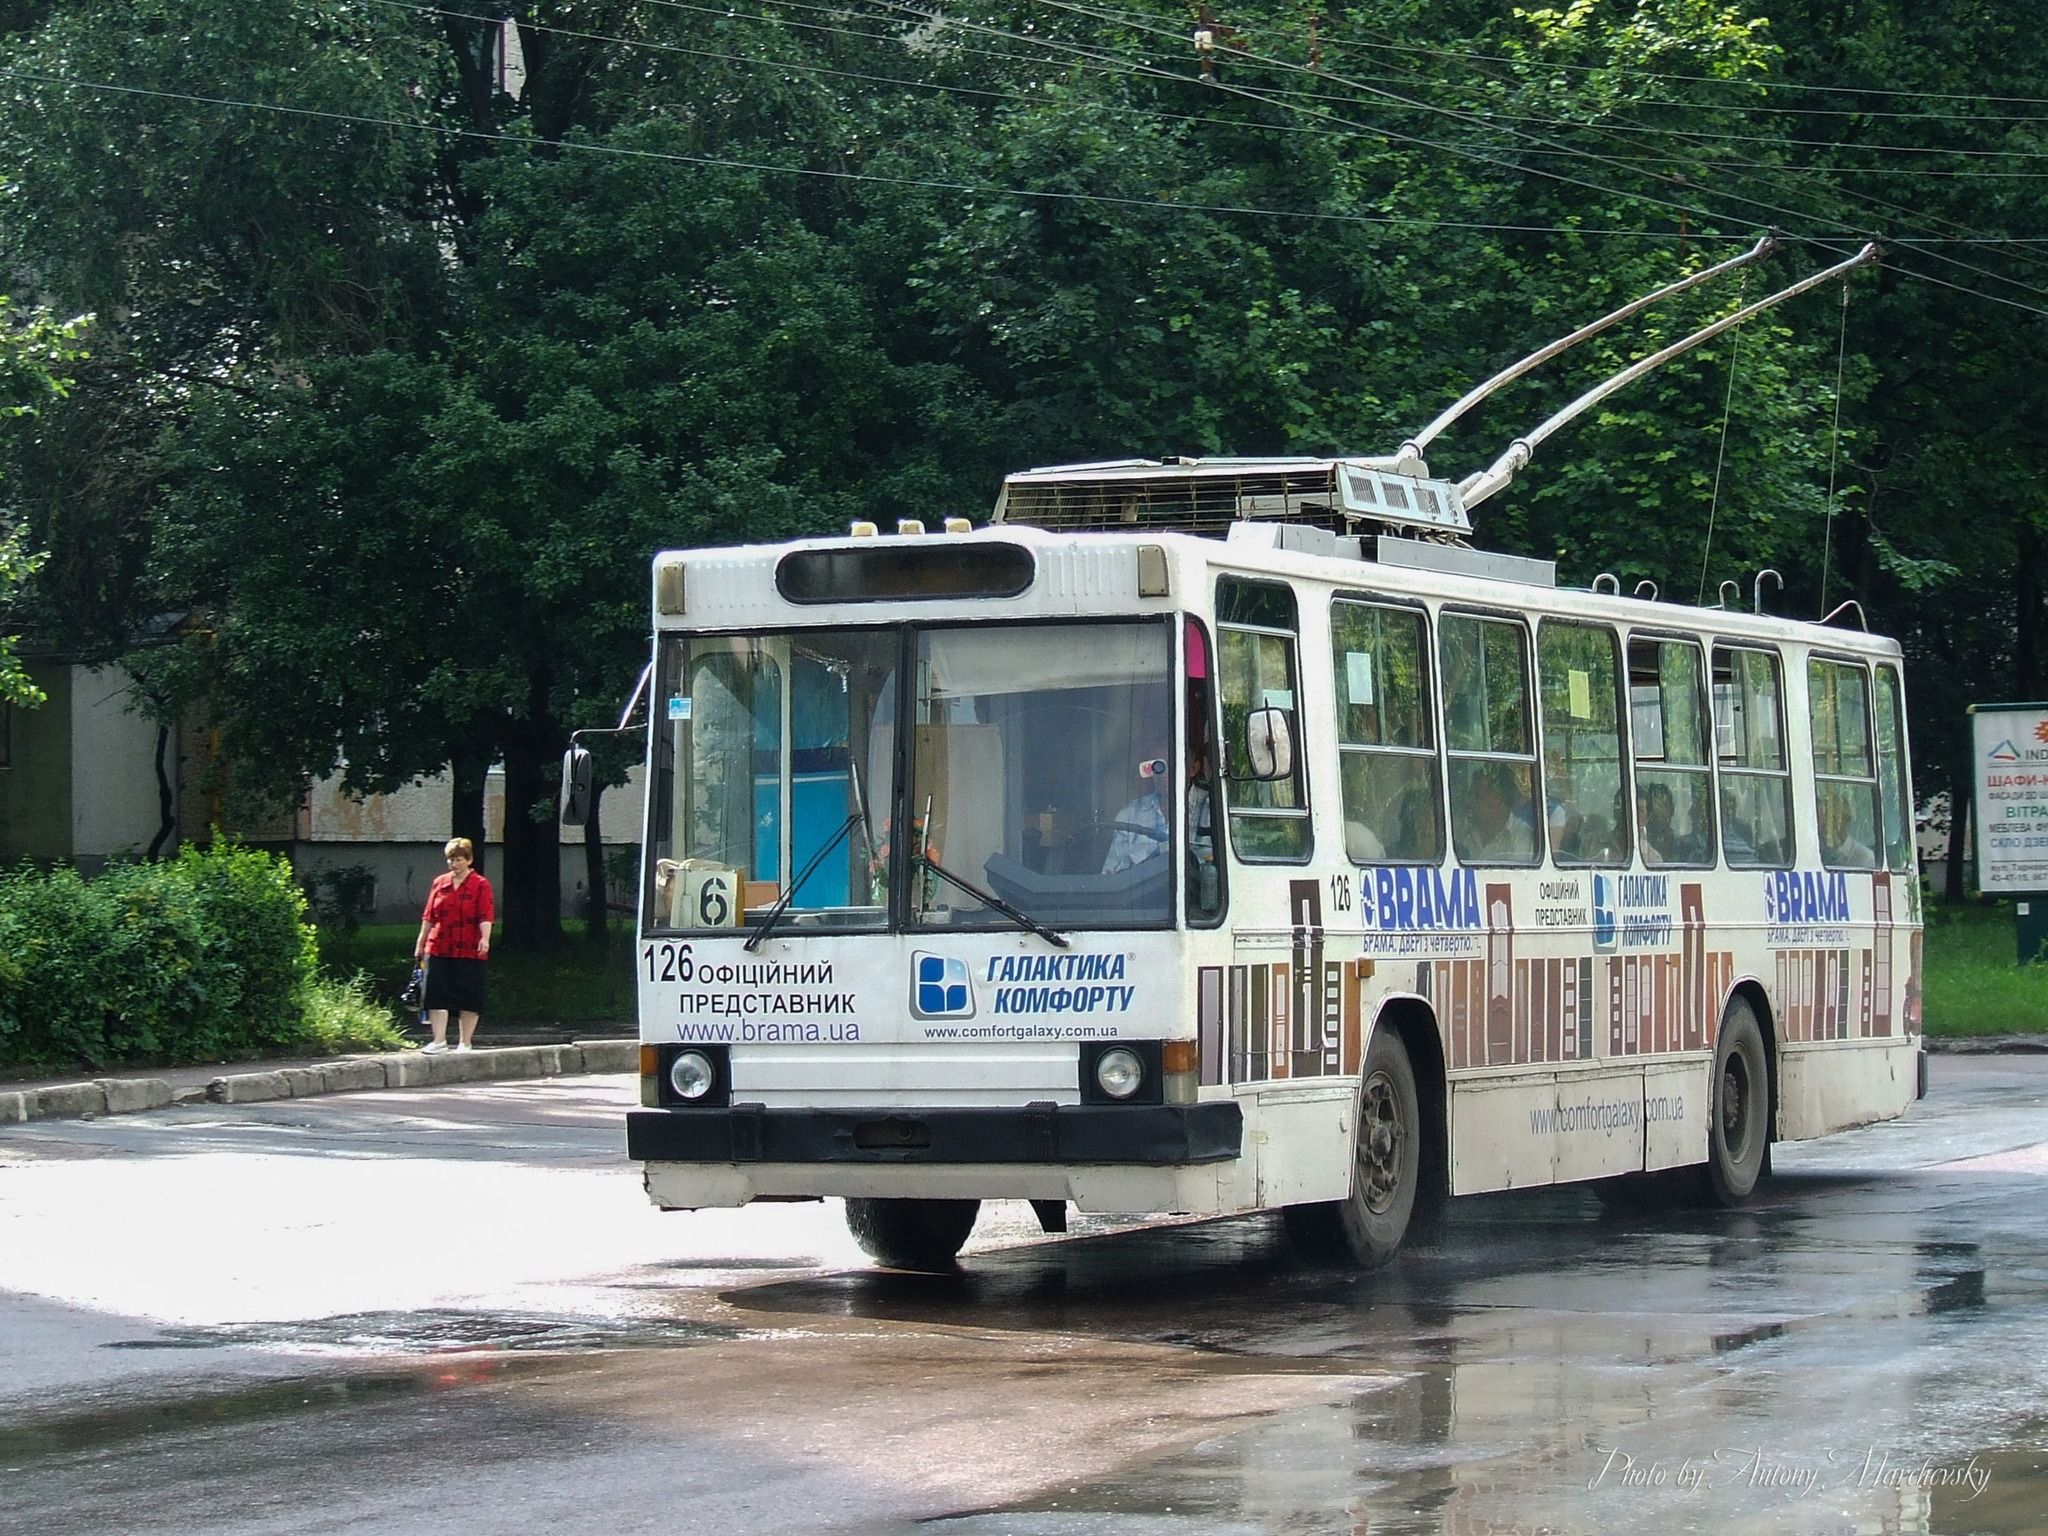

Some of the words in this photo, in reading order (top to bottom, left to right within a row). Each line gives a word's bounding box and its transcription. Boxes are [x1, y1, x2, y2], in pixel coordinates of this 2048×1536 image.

[701, 877, 728, 926] 6
[1331, 875, 1350, 912] 126
[1376, 867, 1482, 929] BRAMA
[1539, 878, 1580, 902] ОФІЦІЙНИЙ
[1618, 875, 1668, 907] ГАЛАКТИКА
[1775, 871, 1850, 922] BRAMA
[1535, 907, 1588, 926] ПРЕДСТАВНИК
[1622, 914, 1672, 946] КОМФОРТУ
[644, 945, 694, 982] 126
[699, 959, 833, 988] ОФІЦІЙНИЙ
[987, 954, 1125, 982] ГАЛАКТИКА
[680, 994, 855, 1017] ПРЕДСТАВНИК
[994, 986, 1135, 1014] КОМФОРТУ
[677, 1018, 860, 1041] www.brama.ua
[924, 1024, 1118, 1040] www.comfortgalaxy.com.ua
